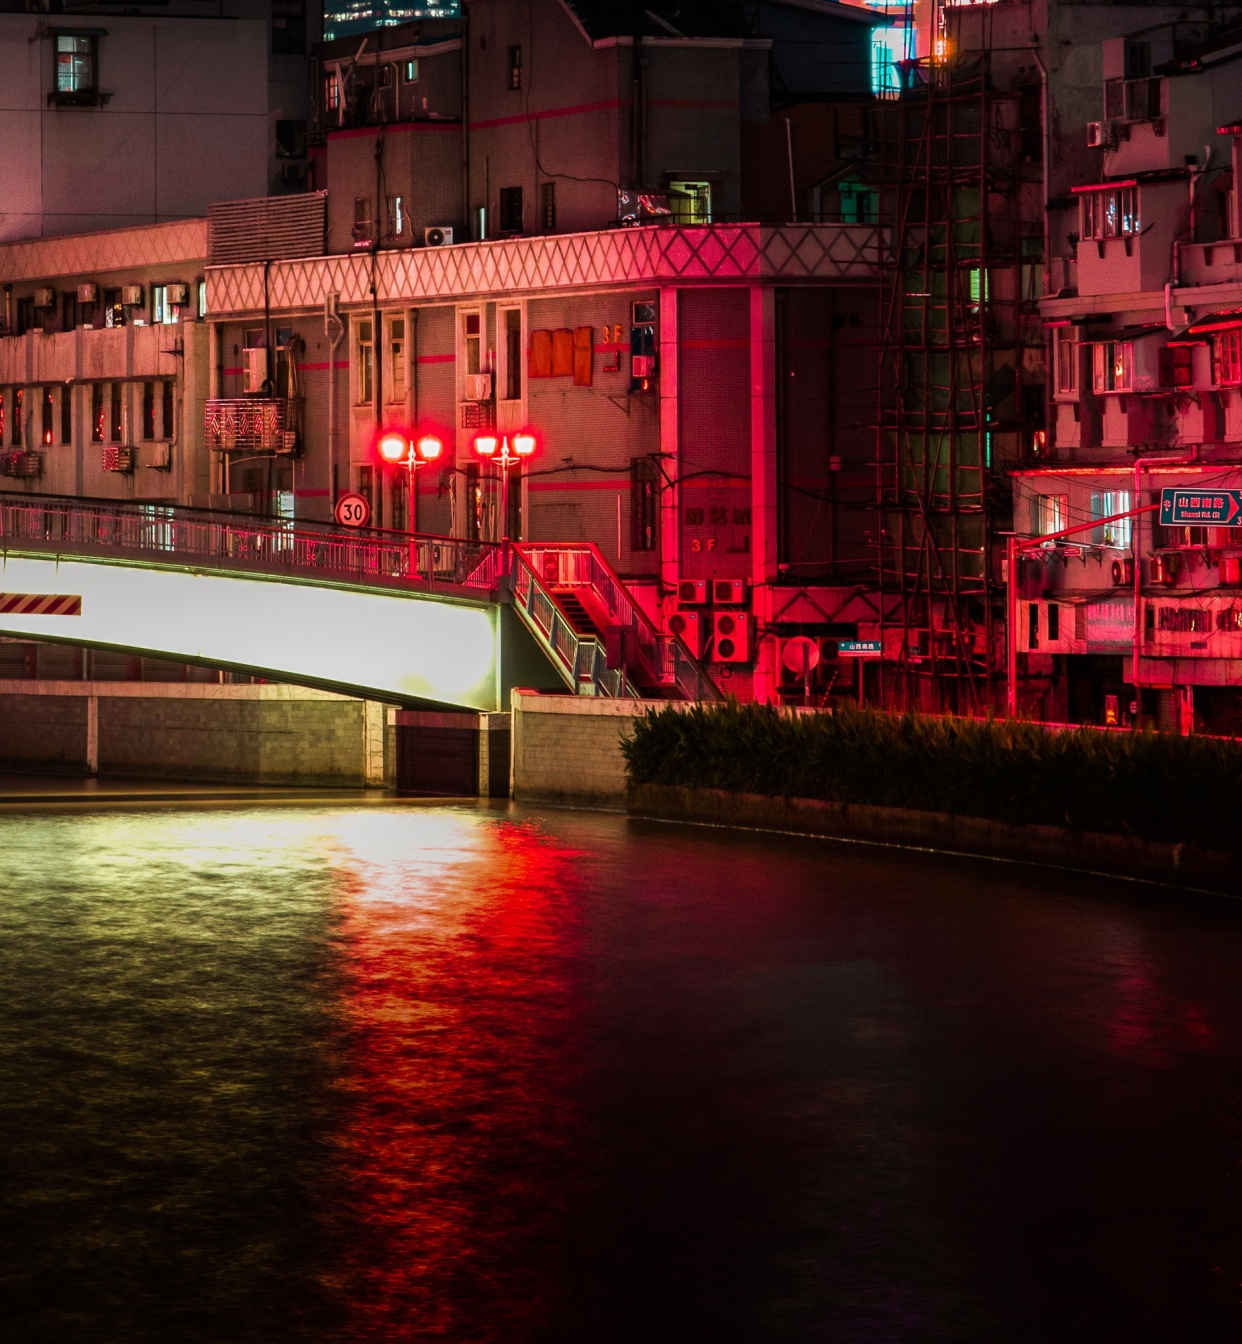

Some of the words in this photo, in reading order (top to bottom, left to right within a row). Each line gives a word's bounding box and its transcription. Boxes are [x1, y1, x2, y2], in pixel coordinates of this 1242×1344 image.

[1178, 497, 1224, 509] 山西南路
[344, 504, 362, 521] 30
[691, 539, 716, 552] 3F
